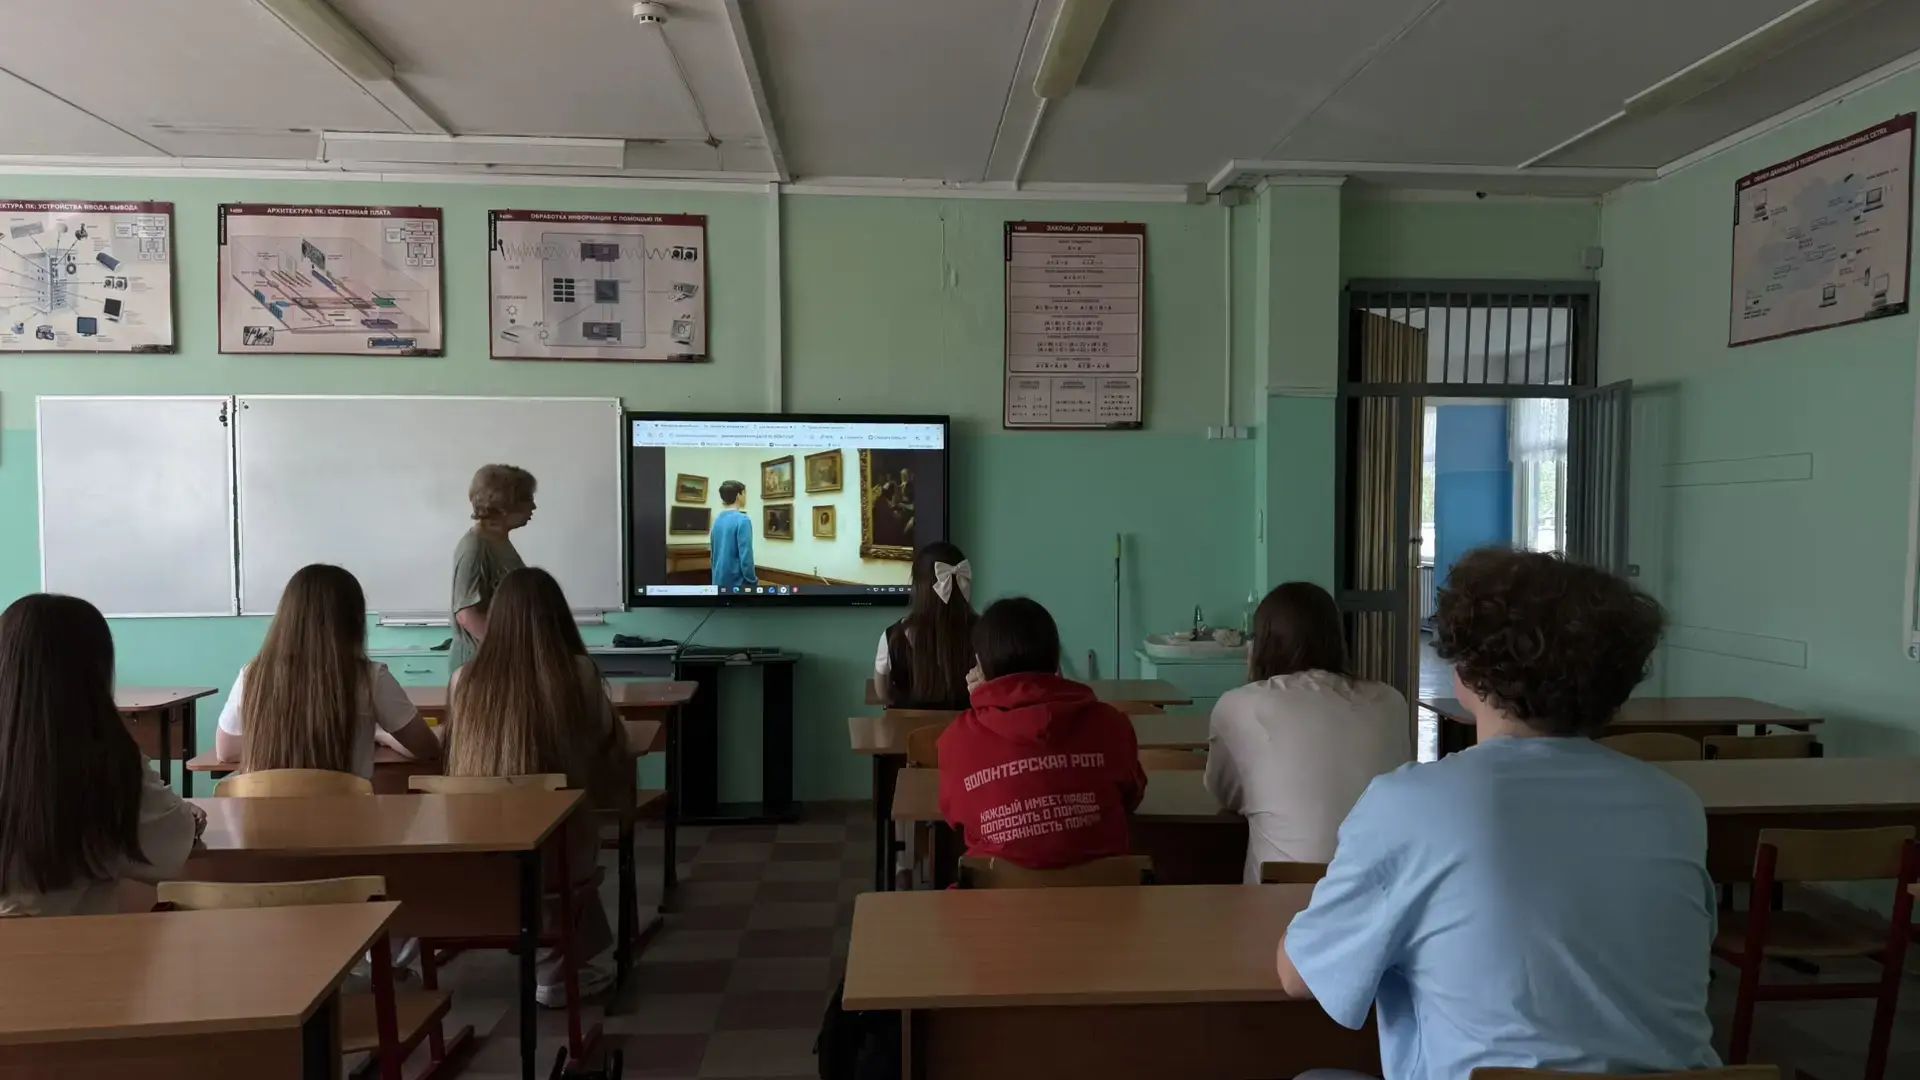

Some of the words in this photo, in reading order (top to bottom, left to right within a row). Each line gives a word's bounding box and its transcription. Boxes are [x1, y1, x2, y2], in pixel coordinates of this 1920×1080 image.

[38, 202, 83, 210] УСТРОЙСТВА
[267, 207, 313, 215] АРХИТЕКТУРА
[963, 754, 1067, 792] ВОЛОНТЕРСКАЯ
[1071, 752, 1105, 768] РОТА
[980, 799, 1023, 823] КАЖДЫЙ
[1024, 794, 1062, 811] ИМЕЕТ
[1062, 792, 1096, 805] ПРАВО
[980, 811, 1041, 835] ПОПРОСИТЬ
[1043, 809, 1052, 820] О
